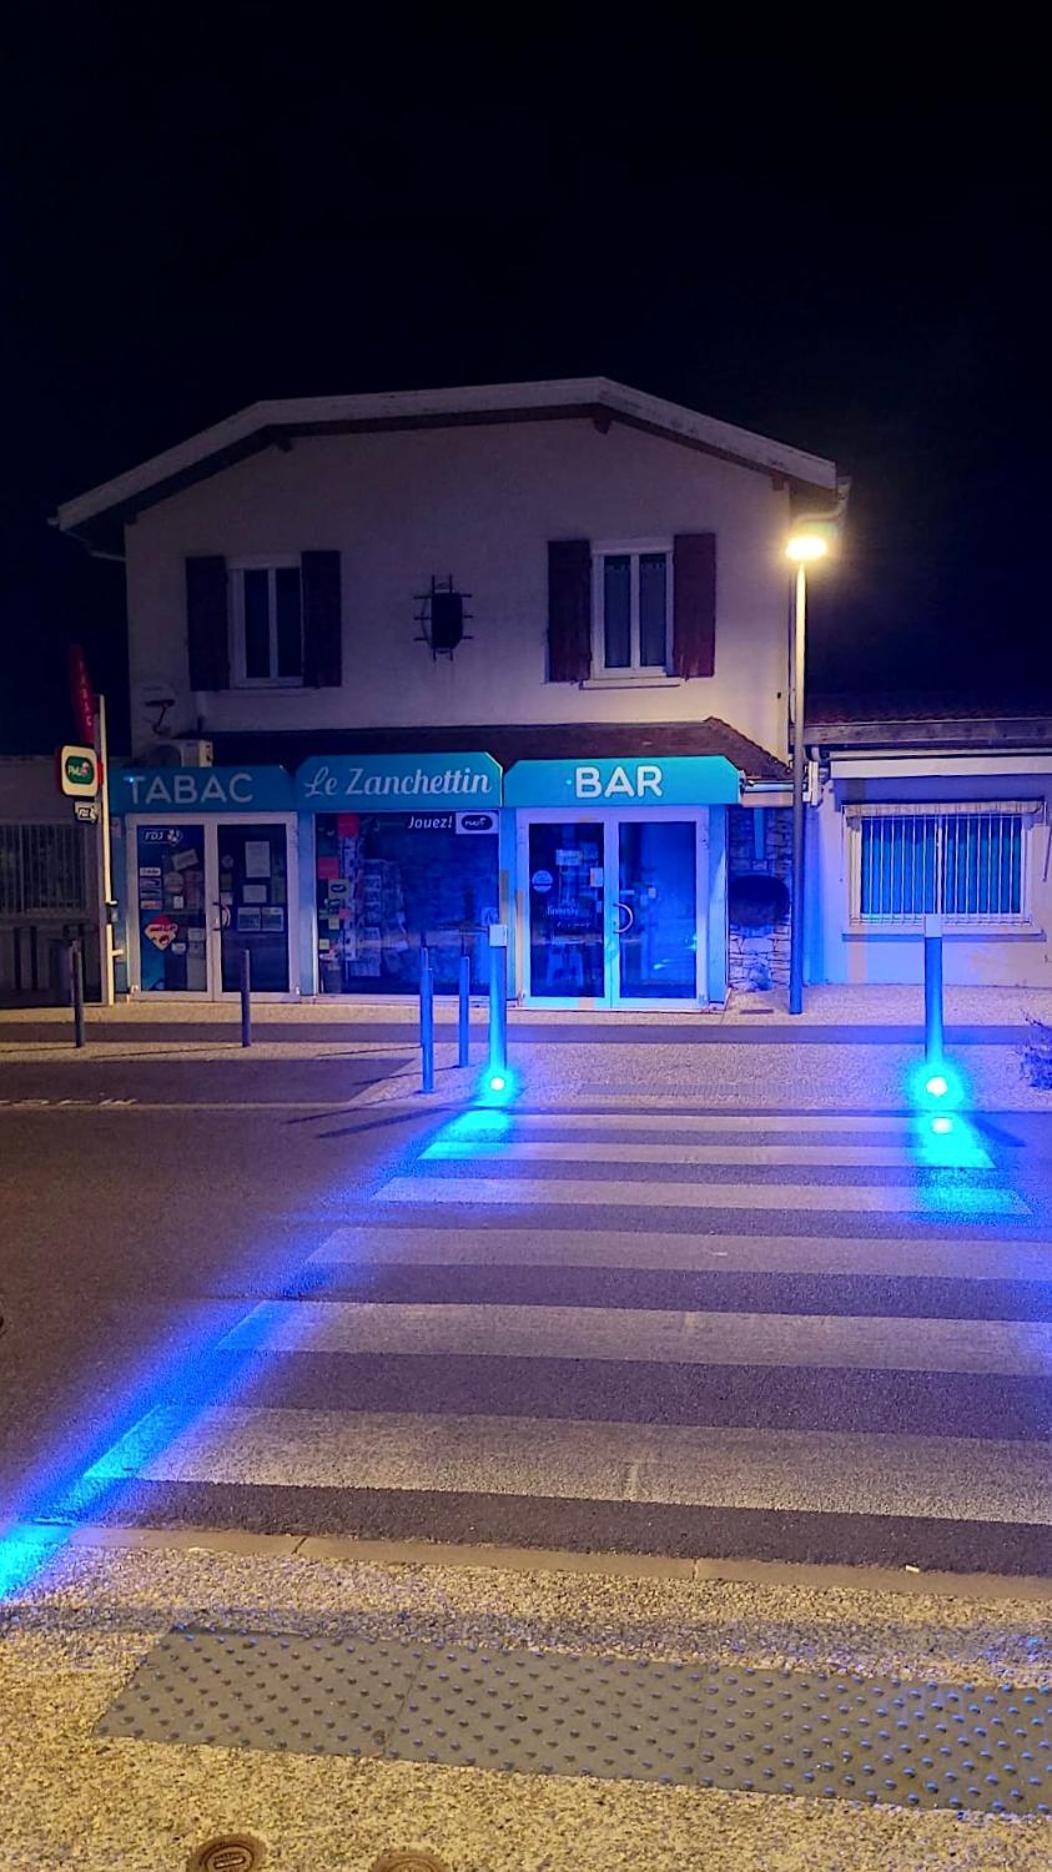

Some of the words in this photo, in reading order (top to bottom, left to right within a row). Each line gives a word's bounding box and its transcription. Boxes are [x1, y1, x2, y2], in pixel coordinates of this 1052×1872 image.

[123, 773, 254, 805] TABAC
[304, 766, 338, 798] Le
[345, 767, 493, 796] Zanchettin
[575, 765, 664, 799] BAR
[407, 815, 453, 829] Jouez!
